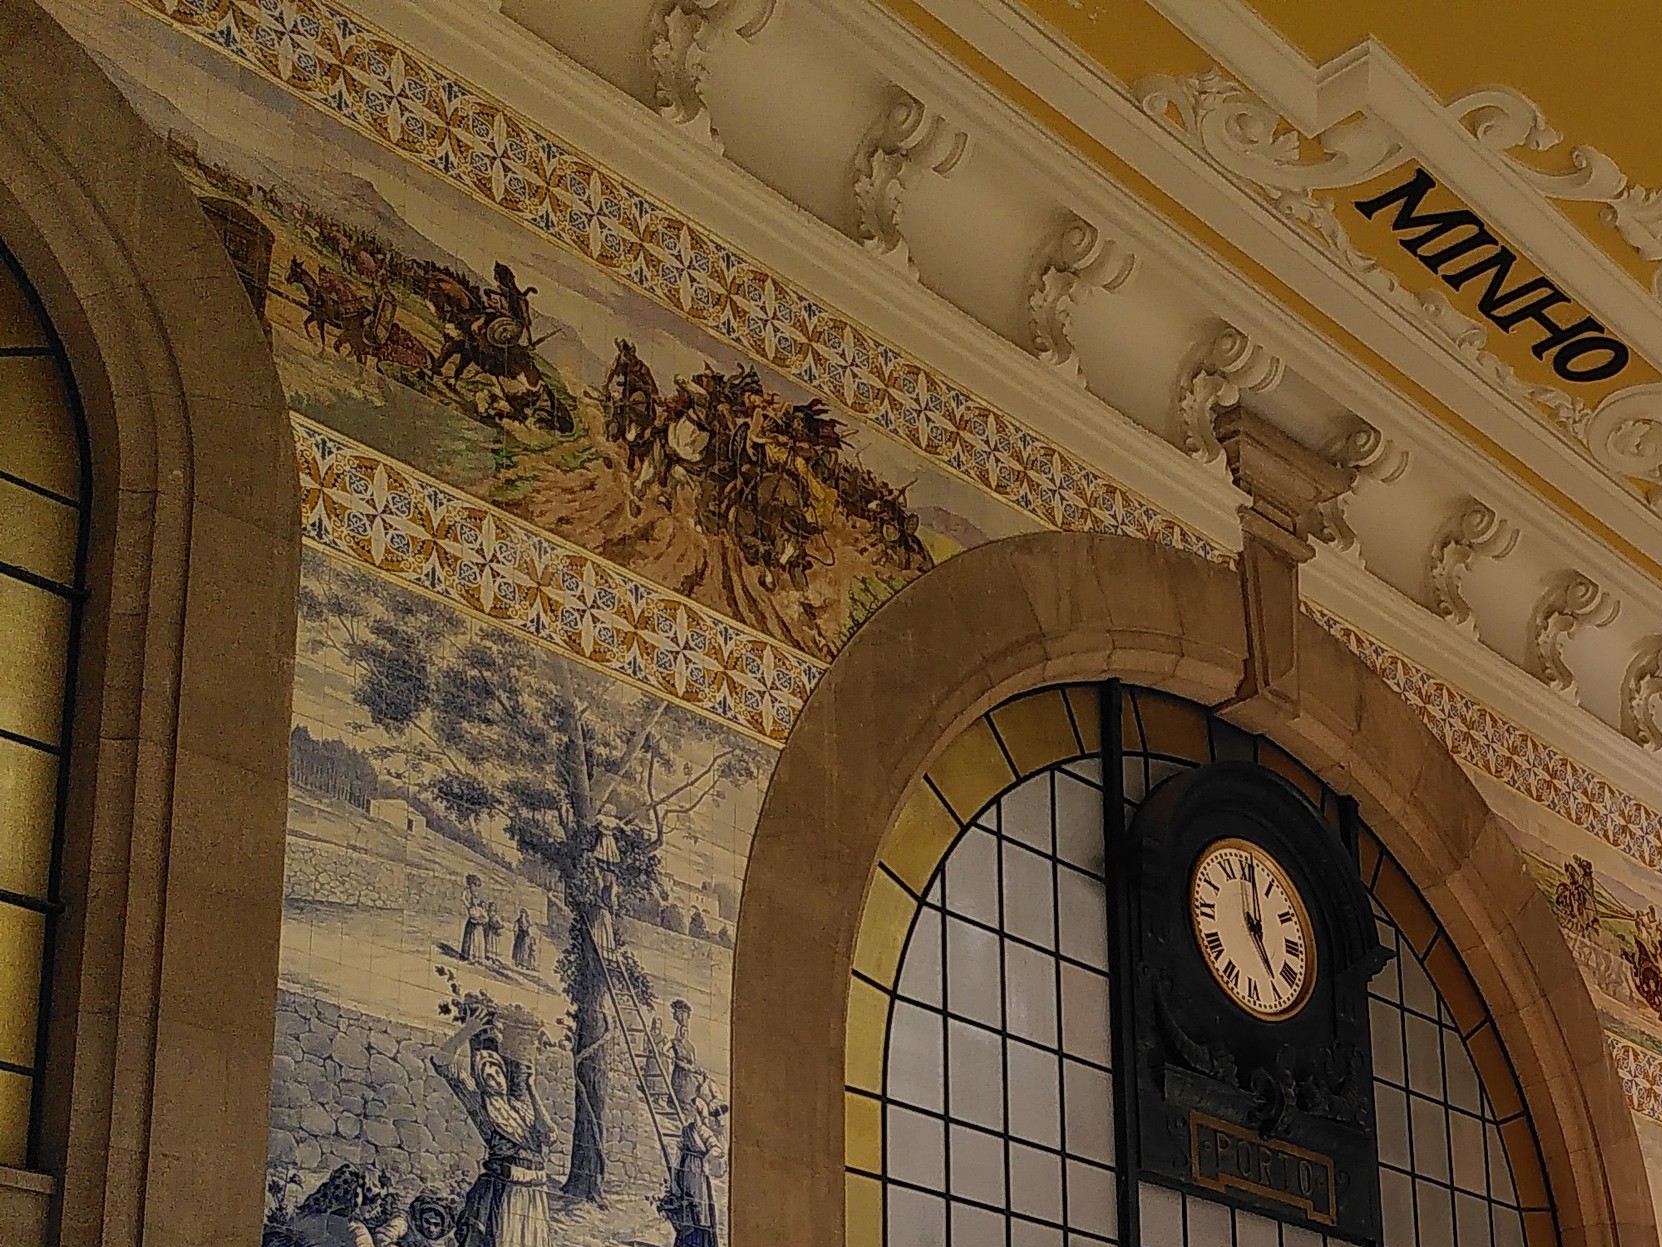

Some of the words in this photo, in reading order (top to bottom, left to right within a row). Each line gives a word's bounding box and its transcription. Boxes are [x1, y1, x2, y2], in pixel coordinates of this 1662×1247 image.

[1354, 168, 1629, 382] MINHO
[1217, 859, 1237, 882] XI
[1265, 877, 1275, 899] I
[1200, 898, 1216, 921] IX
[1278, 911, 1293, 926] II
[1205, 932, 1225, 962] VIII
[1284, 938, 1299, 960] III
[1223, 958, 1240, 989] VII
[1280, 960, 1298, 989] IIII
[1248, 977, 1261, 1001] VI
[1271, 980, 1283, 1002] V
[1216, 1131, 1312, 1196] PORTO
